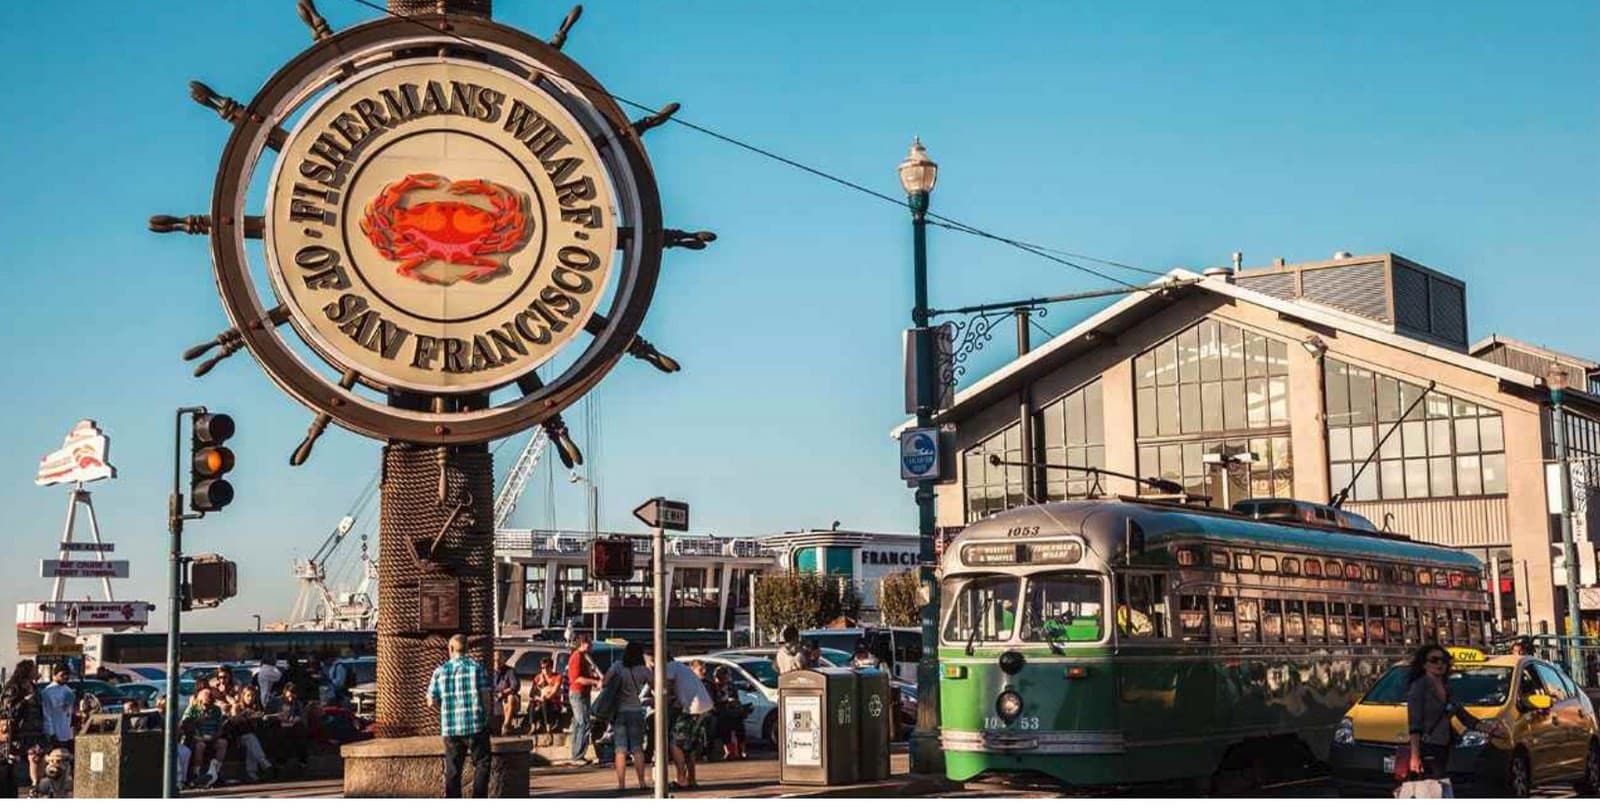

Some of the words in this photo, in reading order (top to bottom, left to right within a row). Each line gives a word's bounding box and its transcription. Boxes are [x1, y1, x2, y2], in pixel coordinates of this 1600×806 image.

[290, 80, 507, 227] FISHERMANS
[502, 98, 603, 229] WHARF
[294, 245, 352, 292] OF
[322, 292, 412, 360] SAN
[409, 245, 601, 374] FRANCISCO
[1007, 526, 1040, 537] 1053
[1020, 717, 1040, 729] 53
